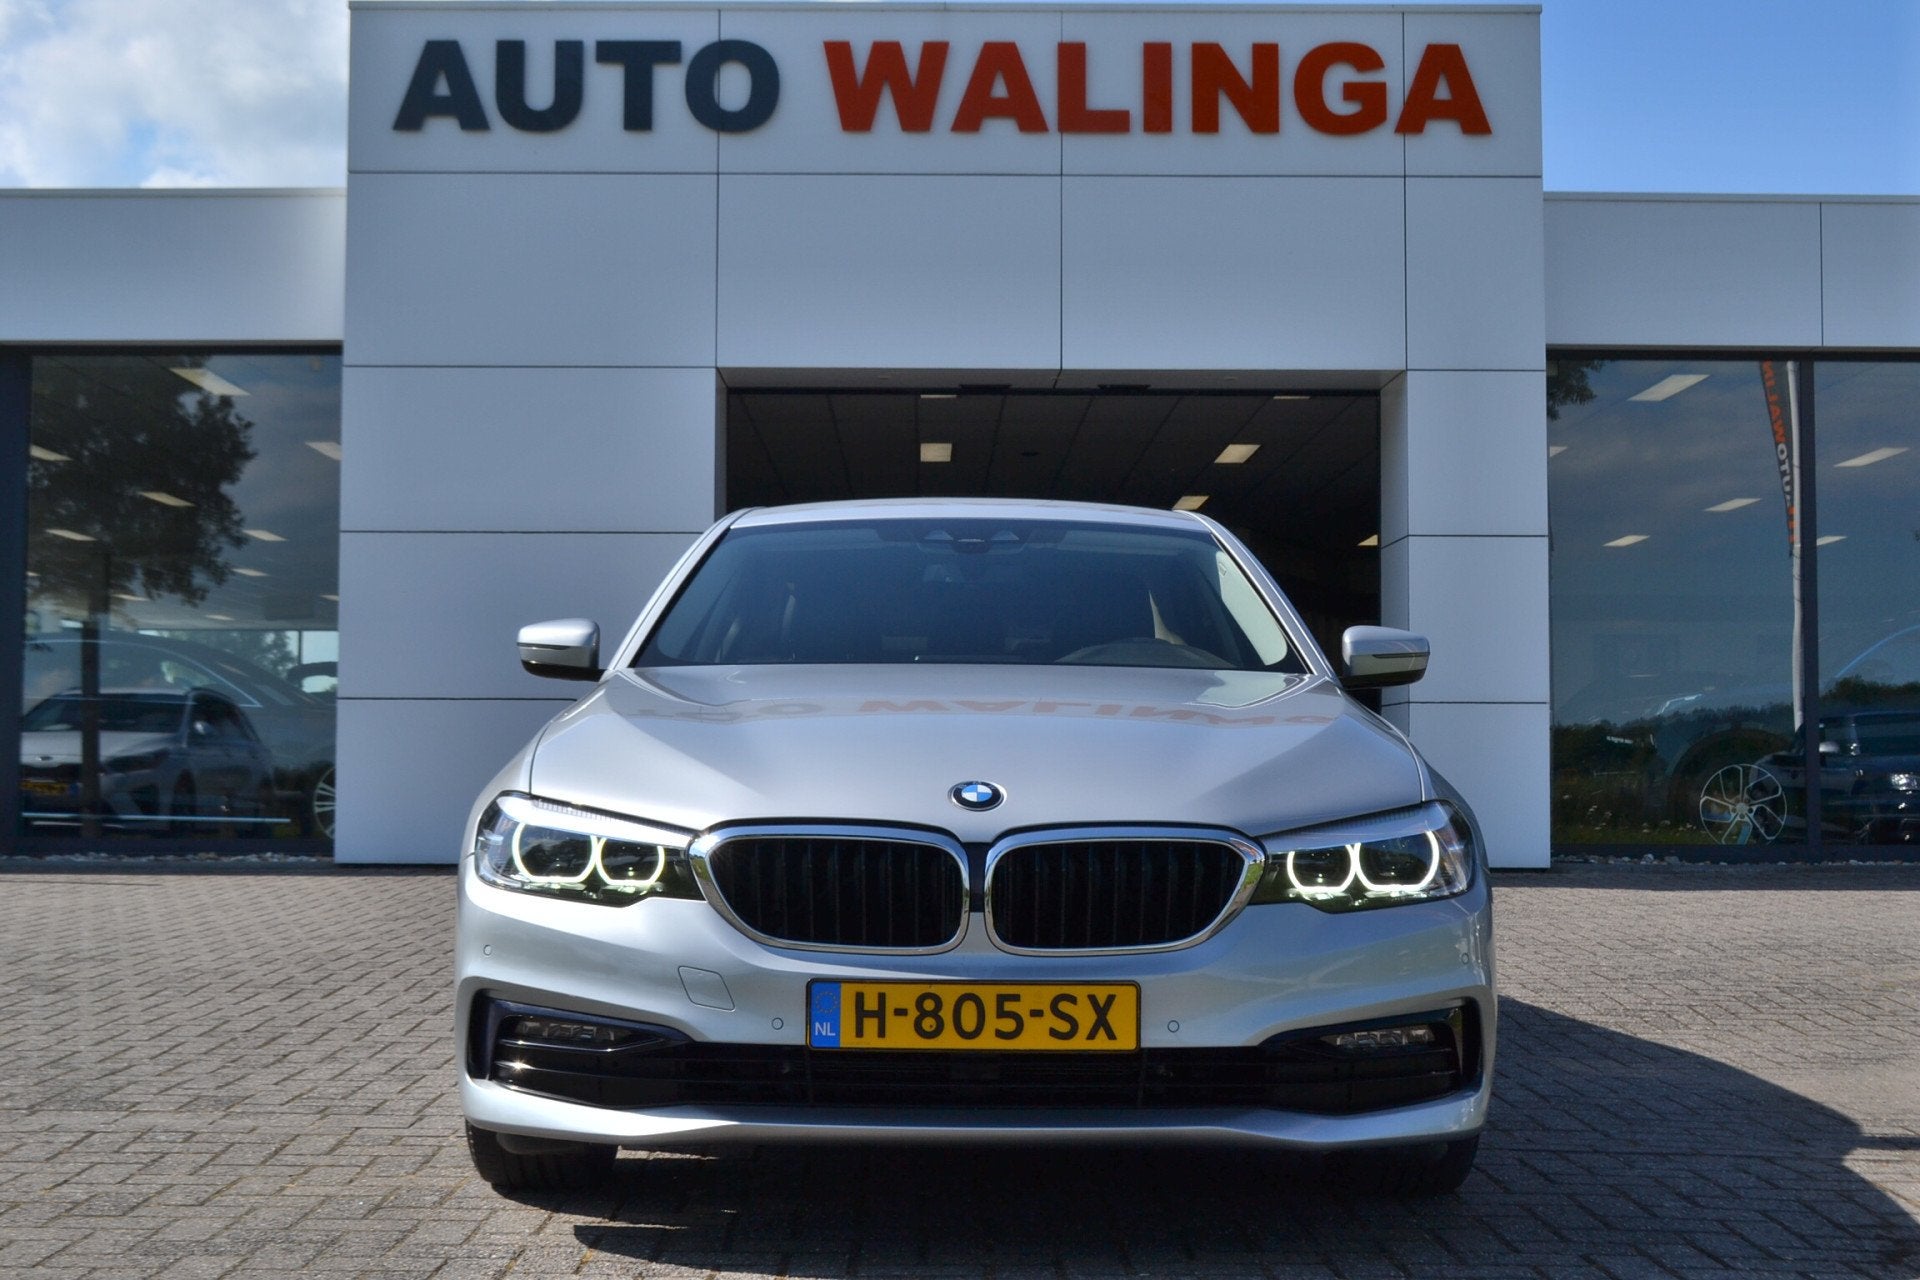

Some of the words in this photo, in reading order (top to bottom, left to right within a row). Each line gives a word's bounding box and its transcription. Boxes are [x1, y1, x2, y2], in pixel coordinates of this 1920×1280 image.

[392, 39, 780, 133] AUTO
[822, 40, 1493, 136] WALINGA
[814, 1021, 836, 1036] NL
[854, 991, 1118, 1041] H-805-SX
